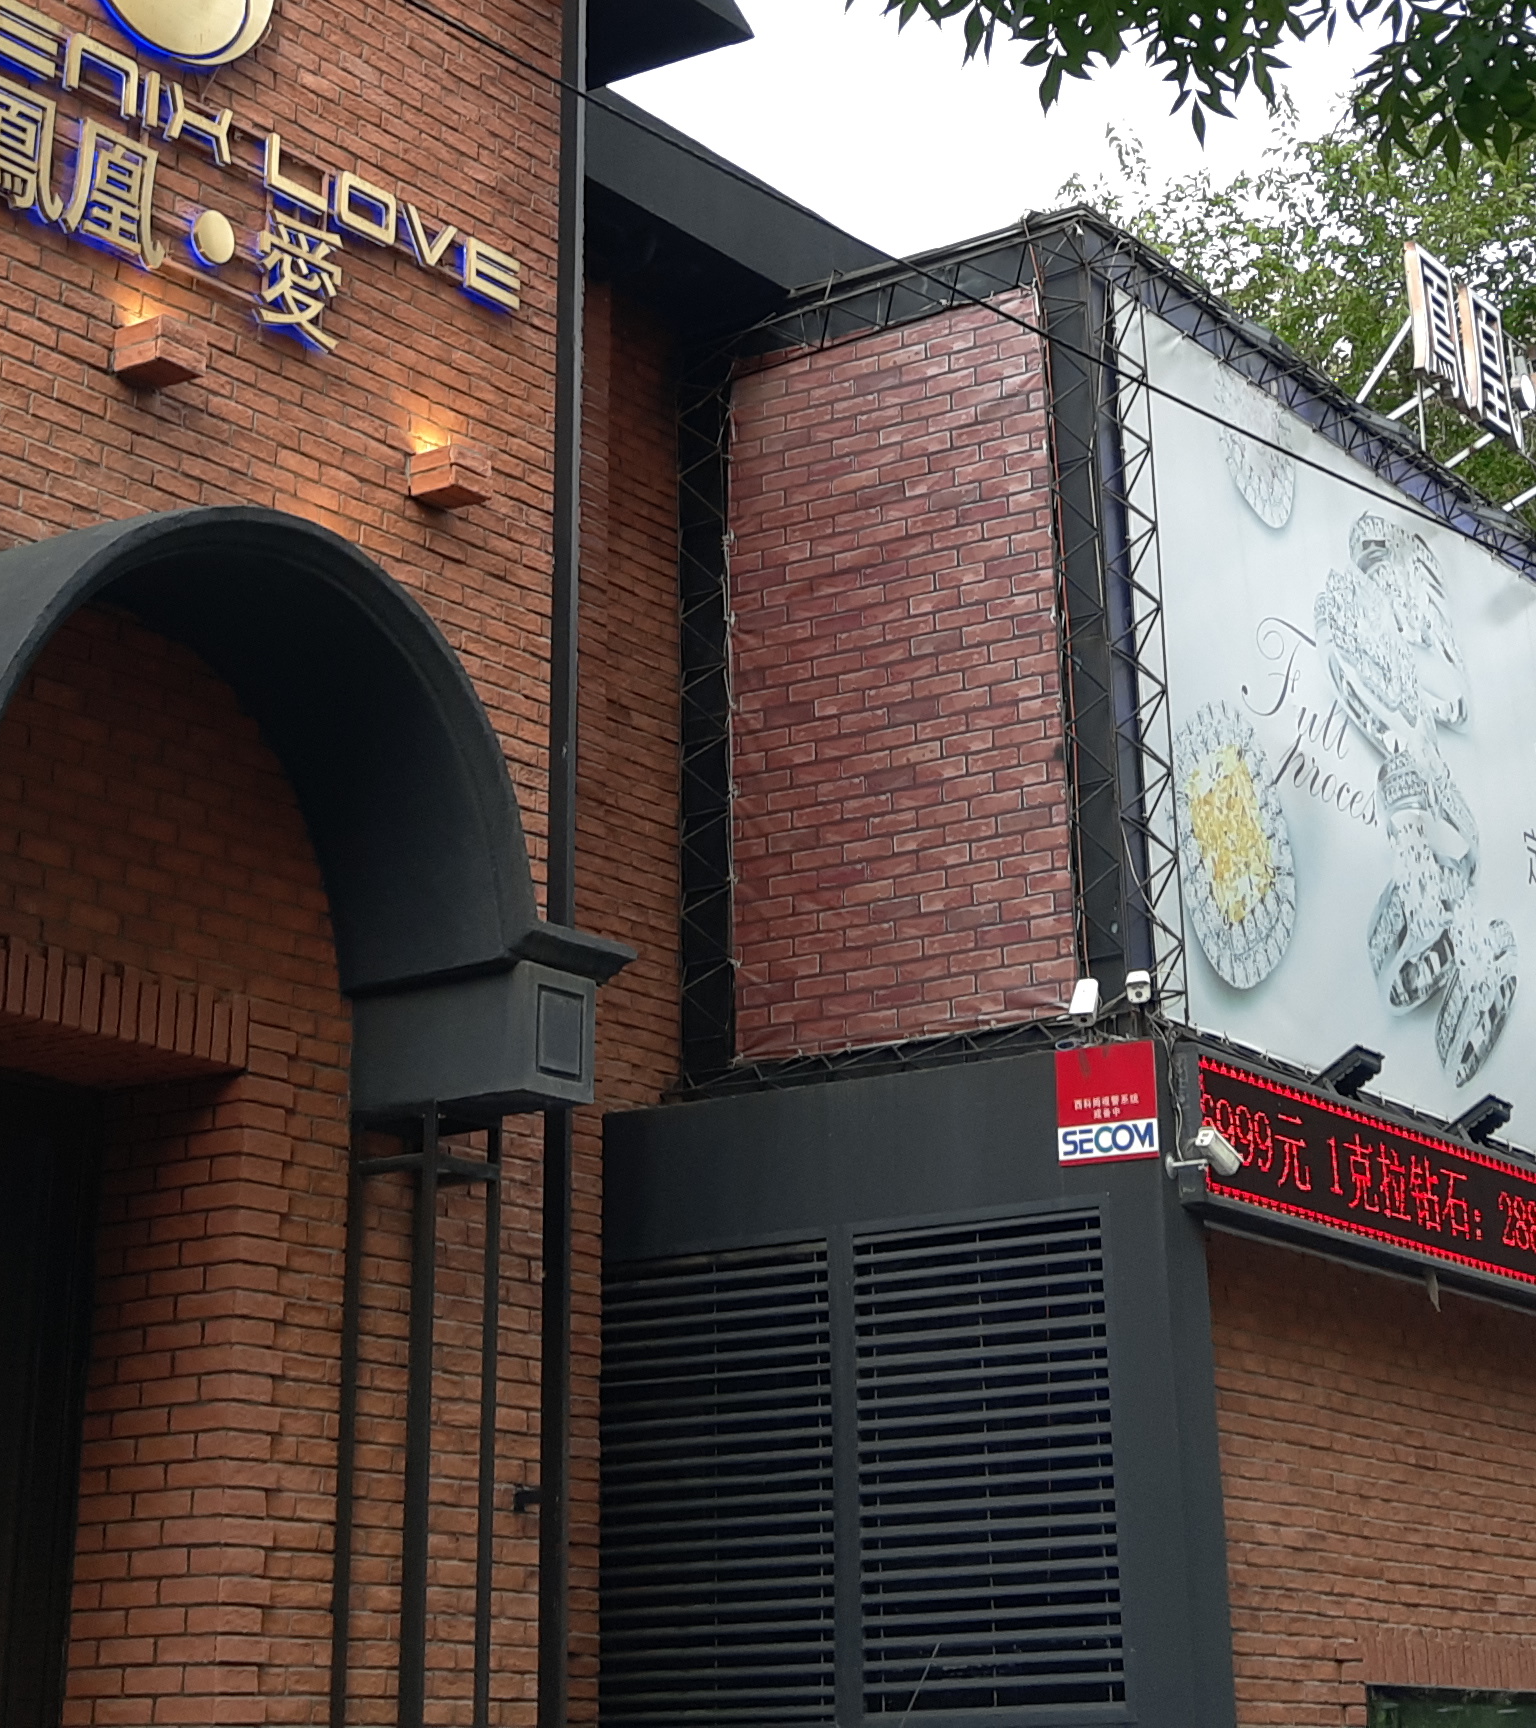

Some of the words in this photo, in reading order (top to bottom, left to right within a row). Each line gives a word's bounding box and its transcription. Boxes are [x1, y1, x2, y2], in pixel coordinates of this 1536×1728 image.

[263, 132, 522, 313] LOVE
[1265, 733, 1378, 827] proces
[1062, 1121, 1155, 1157] SECOM
